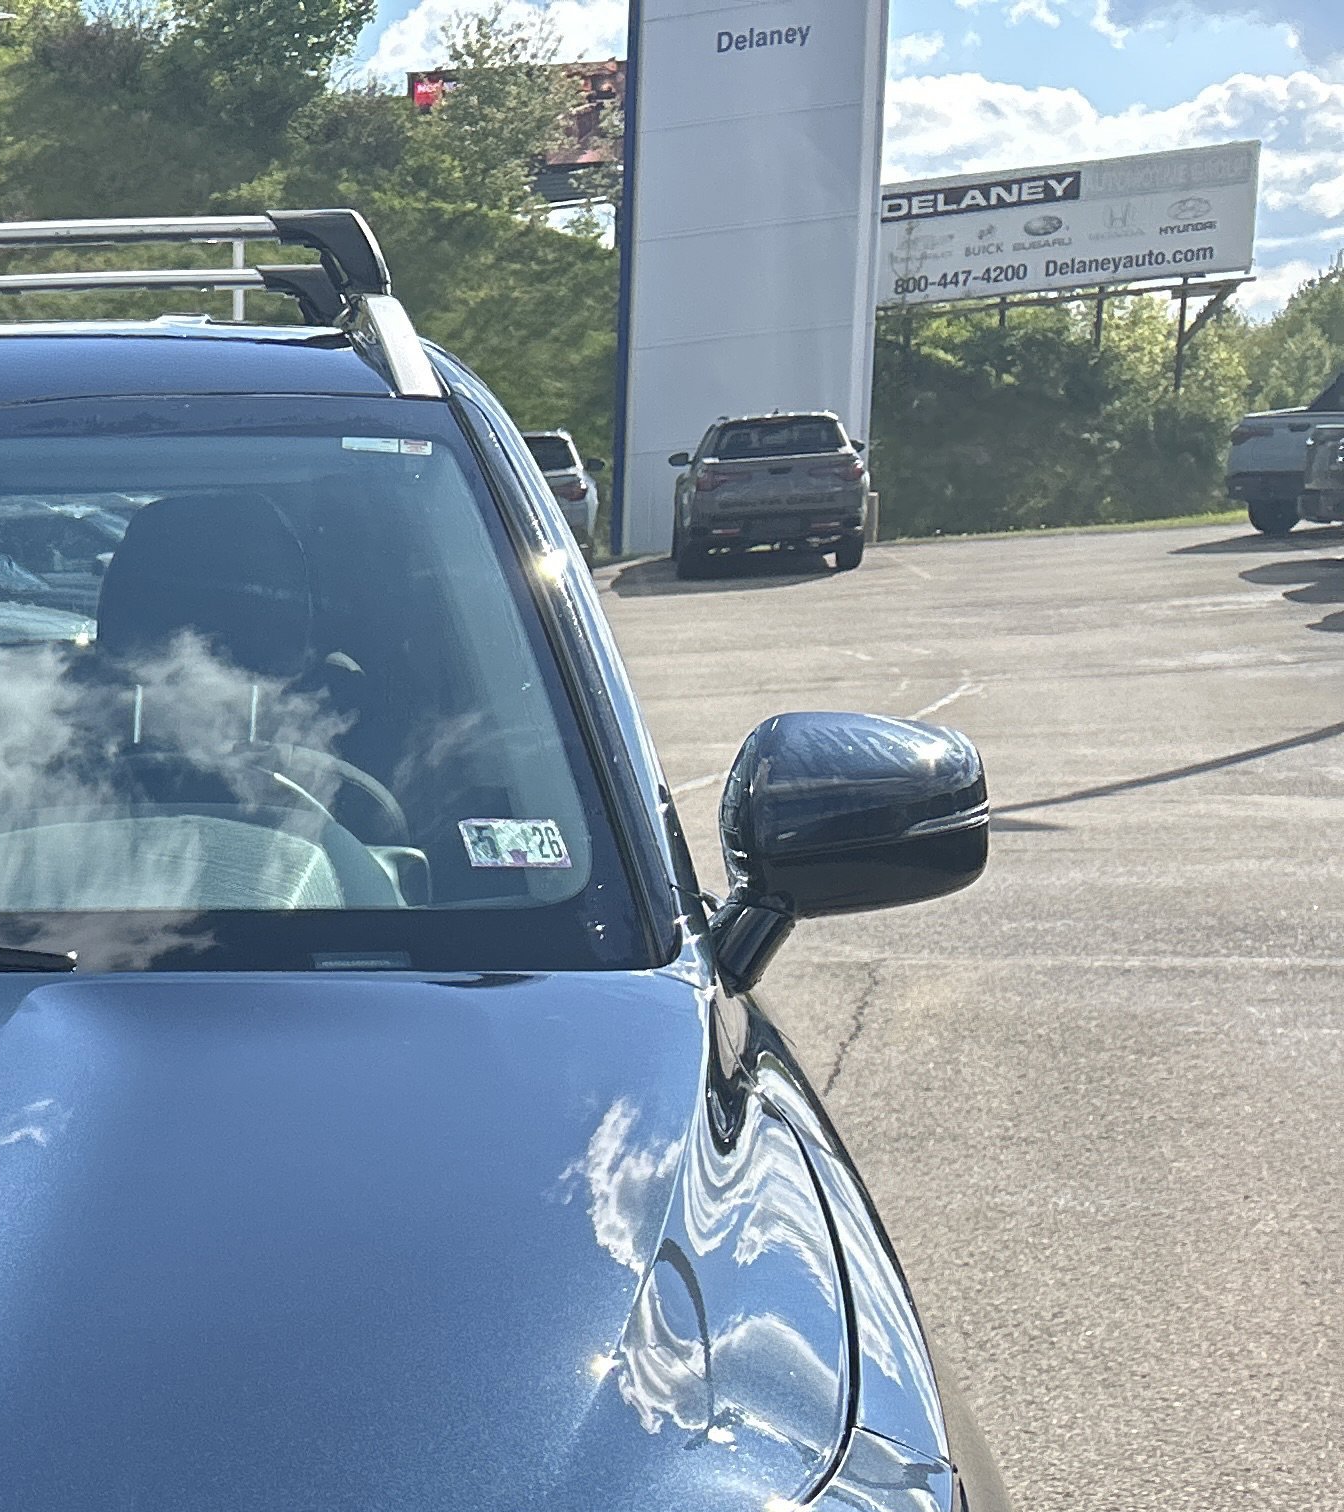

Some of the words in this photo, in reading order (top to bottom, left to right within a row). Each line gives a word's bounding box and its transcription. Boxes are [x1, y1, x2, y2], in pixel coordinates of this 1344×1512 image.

[716, 25, 811, 53] Delaney
[882, 176, 1075, 219] DELANEY
[964, 242, 1004, 258] BUICK
[894, 263, 1028, 295] 800-447-4200
[1045, 245, 1214, 278] Delaneyauto.com
[531, 826, 563, 859] 26
